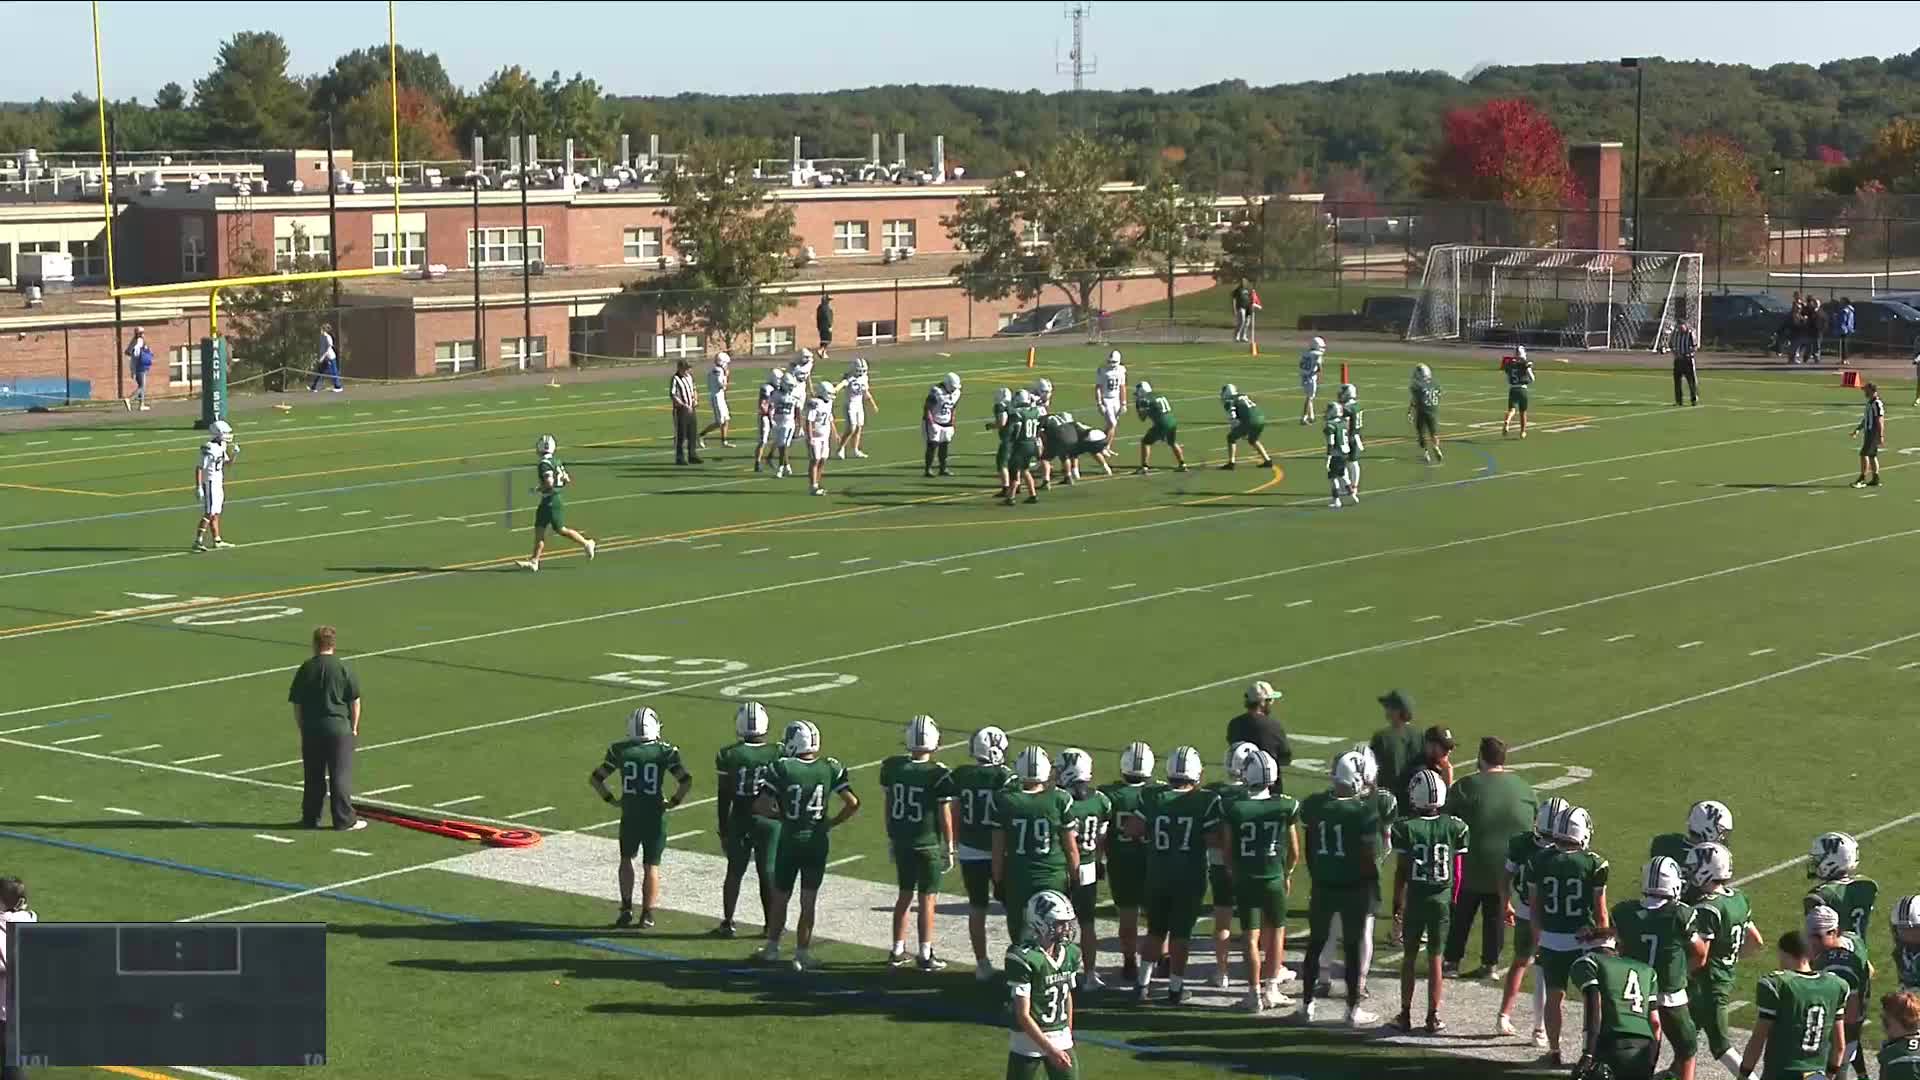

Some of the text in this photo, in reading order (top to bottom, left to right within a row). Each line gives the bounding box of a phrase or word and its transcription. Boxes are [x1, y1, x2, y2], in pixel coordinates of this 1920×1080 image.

[622, 760, 658, 794] 29
[785, 784, 825, 820] 34
[892, 784, 924, 823] 85
[1012, 817, 1050, 855] 79
[1154, 815, 1193, 851] 67
[1240, 821, 1279, 857] 27
[1316, 820, 1345, 857] 11
[1543, 876, 1583, 917] 32
[1640, 934, 1658, 968] 7
[1624, 969, 1644, 1014] 4
